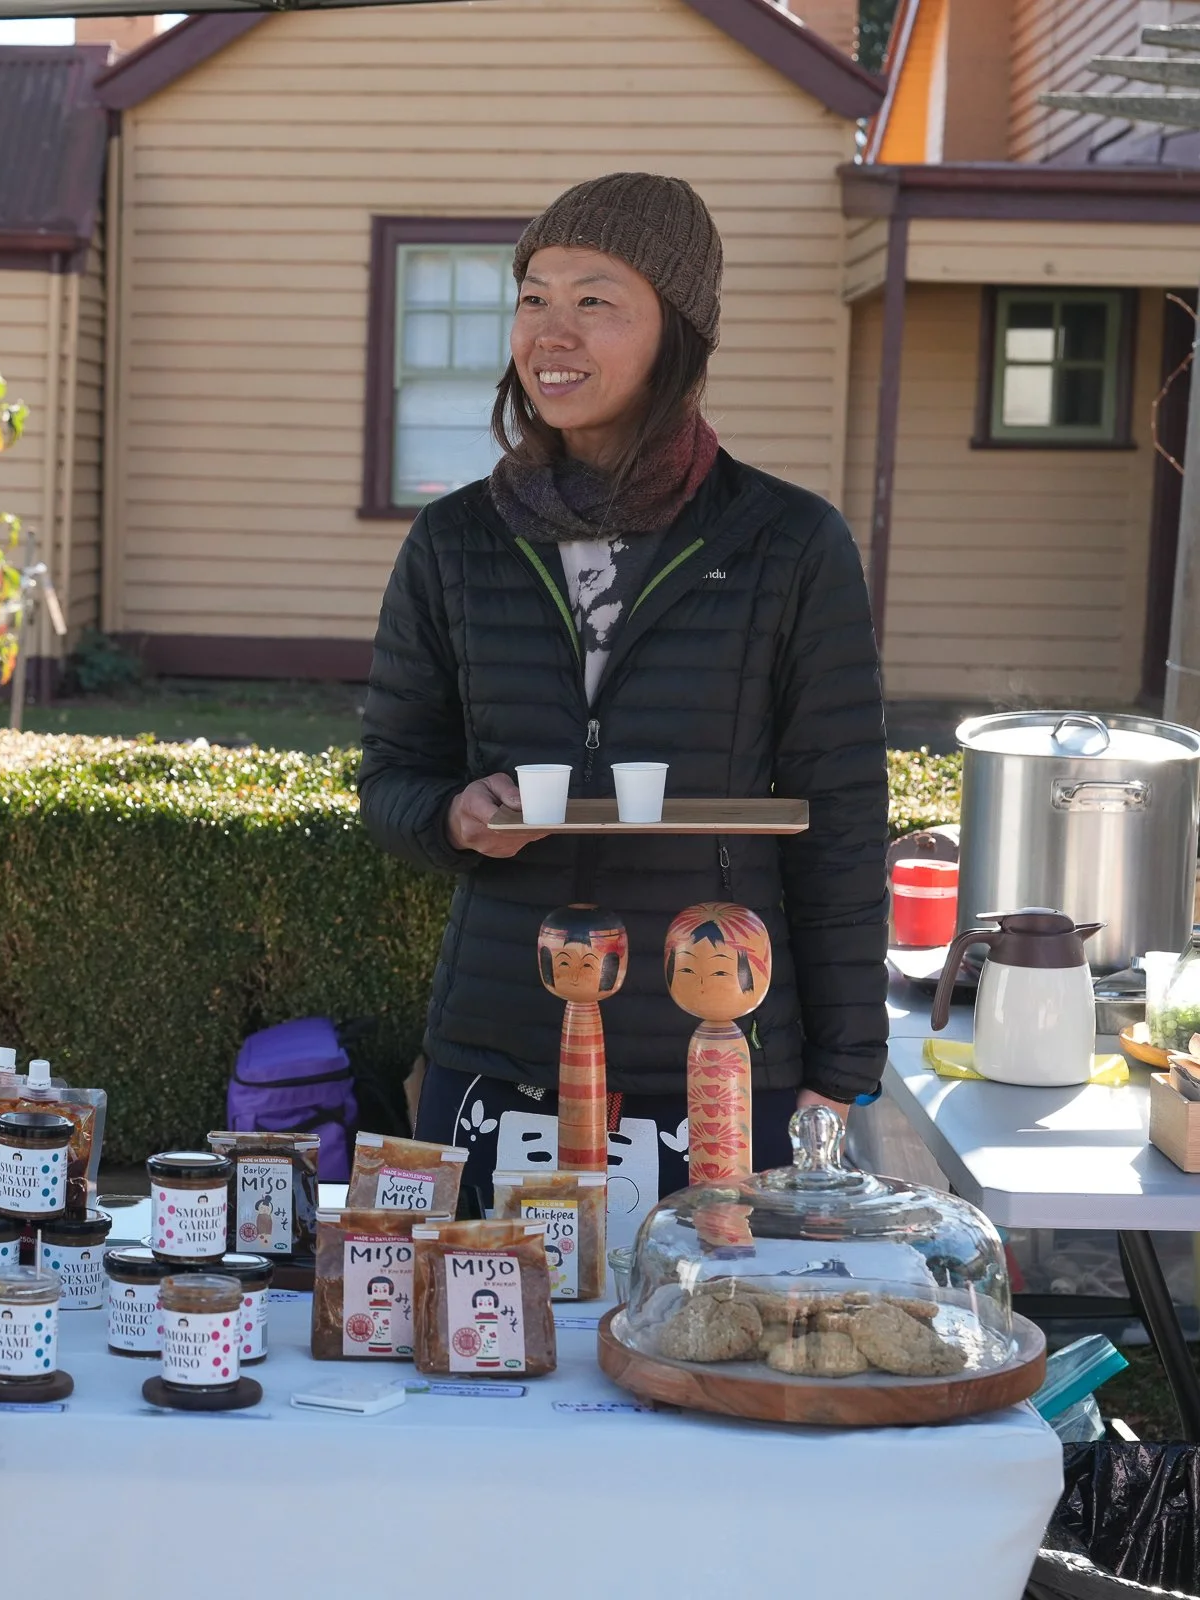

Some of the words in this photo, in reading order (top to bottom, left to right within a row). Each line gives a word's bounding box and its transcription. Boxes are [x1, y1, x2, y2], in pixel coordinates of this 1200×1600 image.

[0, 1162, 38, 1176] SWEET
[243, 1165, 271, 1178] Barley
[241, 1176, 287, 1195] MISO
[387, 1175, 424, 1194] Sweet
[3, 1185, 31, 1199] MISO
[381, 1190, 428, 1210] MISO
[176, 1206, 223, 1218] SMOKED
[526, 1206, 575, 1222] Chickpea
[179, 1219, 221, 1230] GARLIC
[546, 1222, 574, 1240] ISO
[185, 1231, 217, 1242] MISO
[350, 1245, 412, 1268] MISO
[63, 1262, 100, 1273] SWEET
[452, 1258, 515, 1280] MISO
[68, 1285, 97, 1296] MISO
[112, 1311, 153, 1325] GARLIC
[116, 1323, 146, 1337] MISO
[164, 1342, 207, 1357] GARLIC
[168, 1355, 200, 1369] MISO
